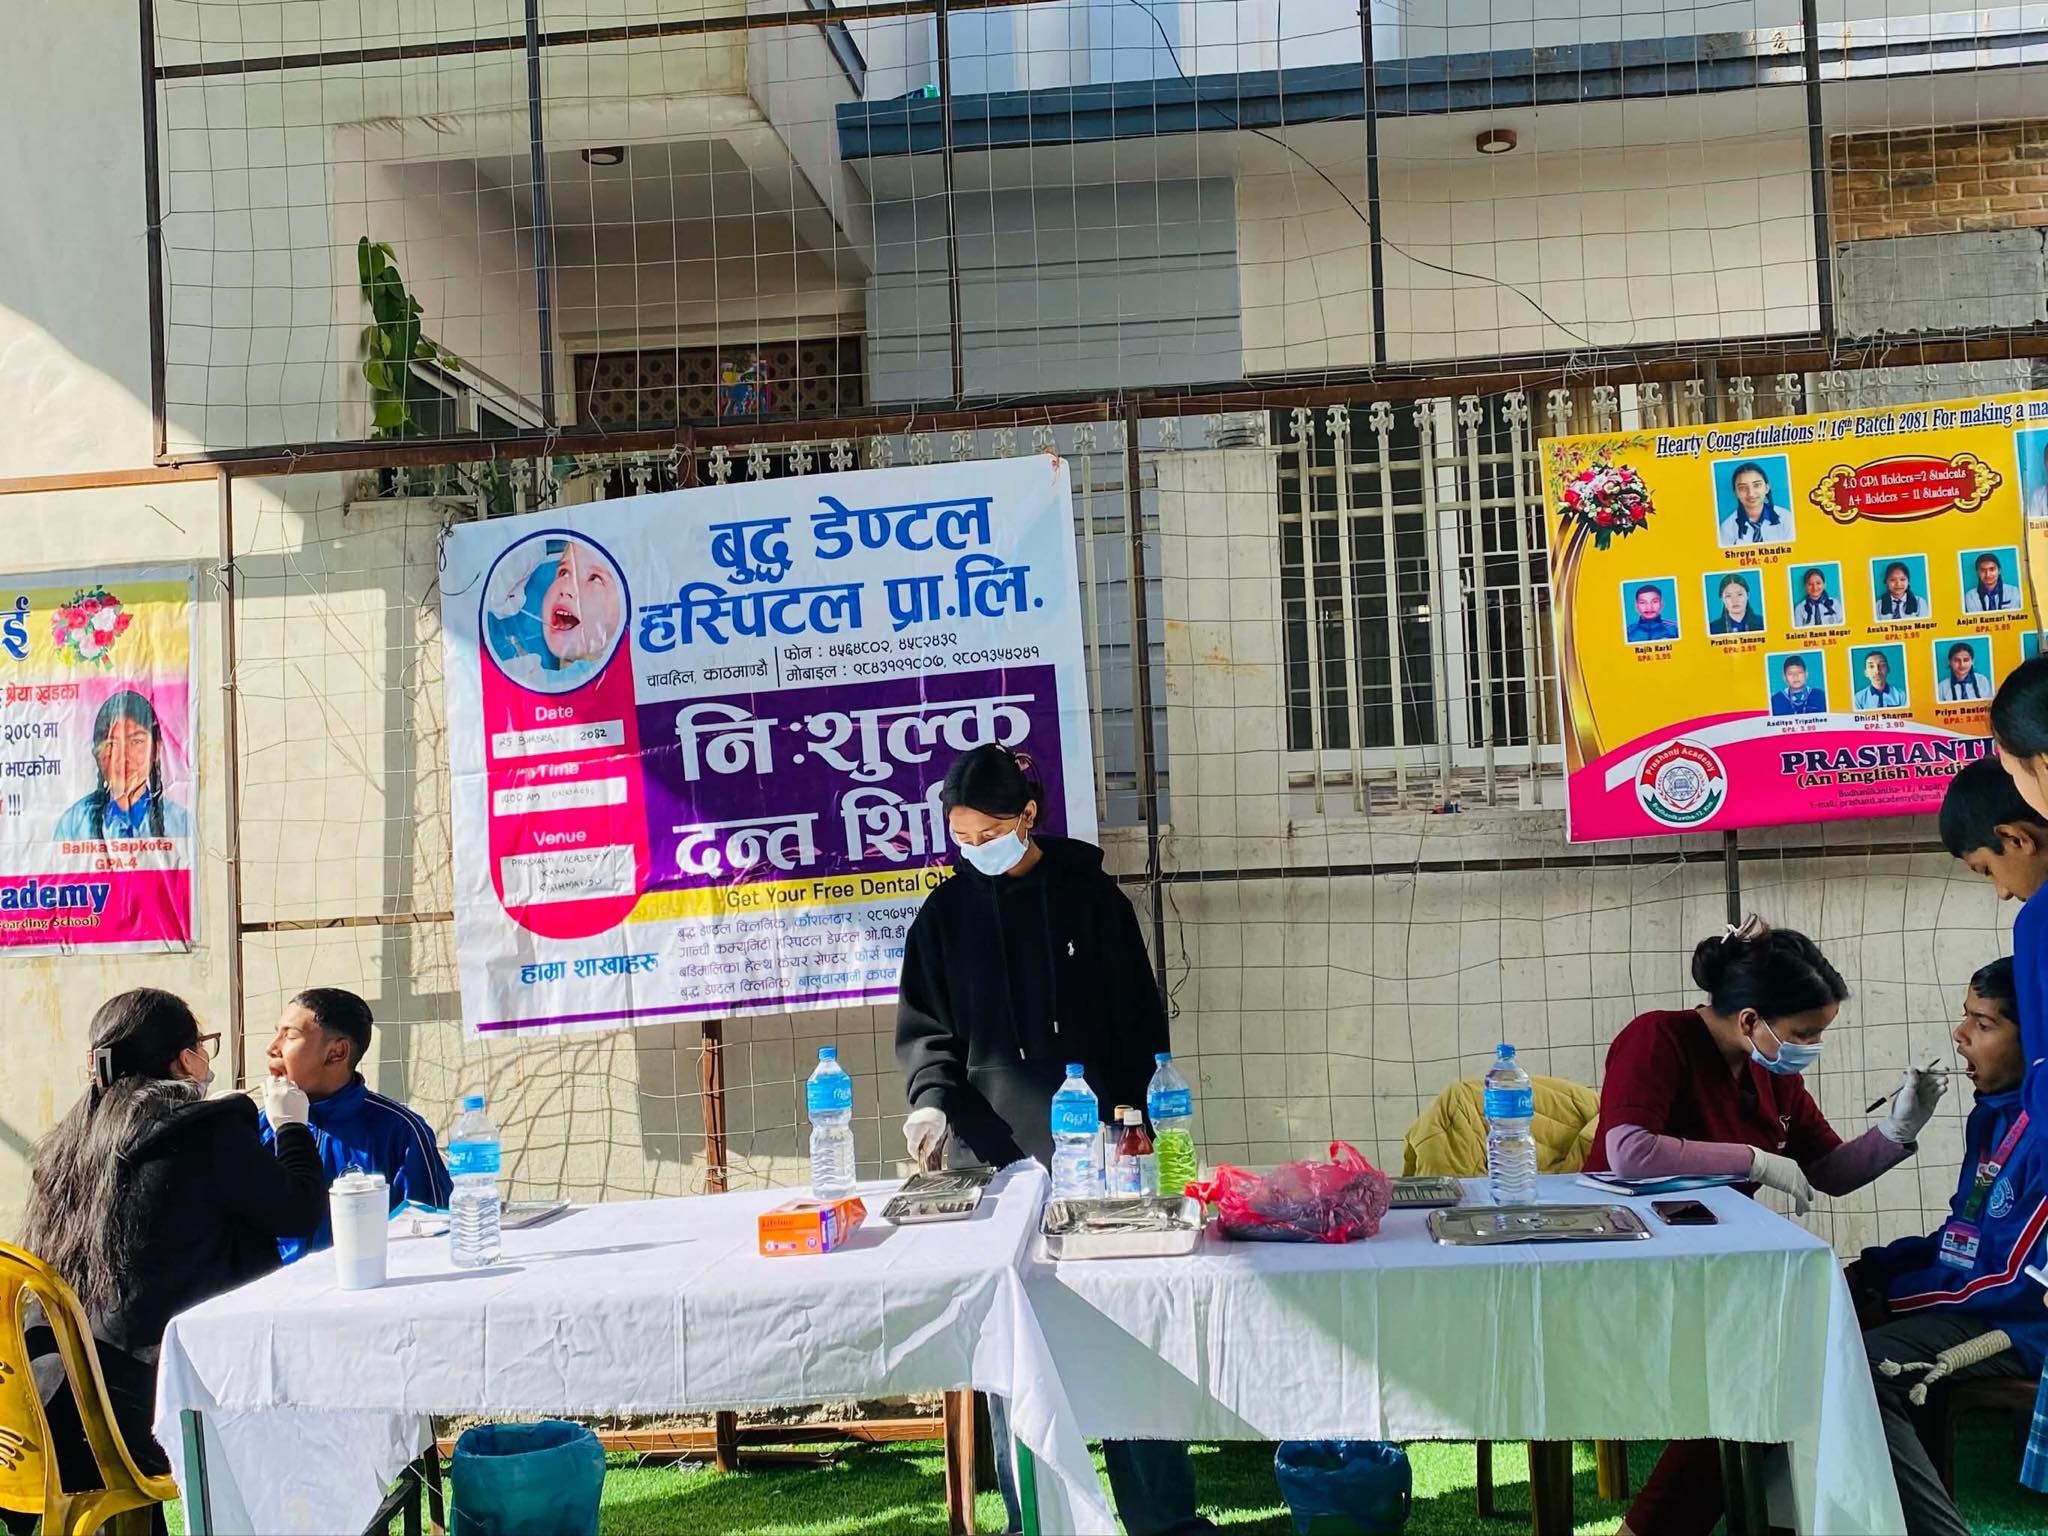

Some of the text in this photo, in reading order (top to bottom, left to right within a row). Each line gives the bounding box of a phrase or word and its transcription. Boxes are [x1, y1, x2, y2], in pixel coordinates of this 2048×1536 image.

[1656, 434, 1704, 459] Hearty
[1706, 422, 1814, 456] Congratulations
[1855, 411, 1895, 435] Batch
[1899, 409, 1928, 430] 2081
[1932, 406, 1957, 427] For
[1960, 401, 2012, 426] making
[2015, 405, 2025, 418] a
[709, 495, 994, 584] बुद्ध डेण्टल
[1763, 555, 1779, 565] 4.0
[638, 579, 865, 655] हस्पिटल
[783, 643, 813, 663] फोन
[534, 704, 574, 722] Date
[1881, 711, 1914, 721] Sharma
[4, 722, 41, 745] २०८१
[1681, 746, 1716, 773] Academy
[539, 762, 580, 778] Time
[1838, 766, 1909, 786] English
[61, 839, 174, 856] Balika Sapkota
[532, 829, 588, 847] Venue
[672, 812, 819, 876] दन्त
[726, 888, 760, 908] Get
[766, 885, 807, 904] Your
[812, 881, 855, 900] Free
[861, 873, 920, 896] Dental
